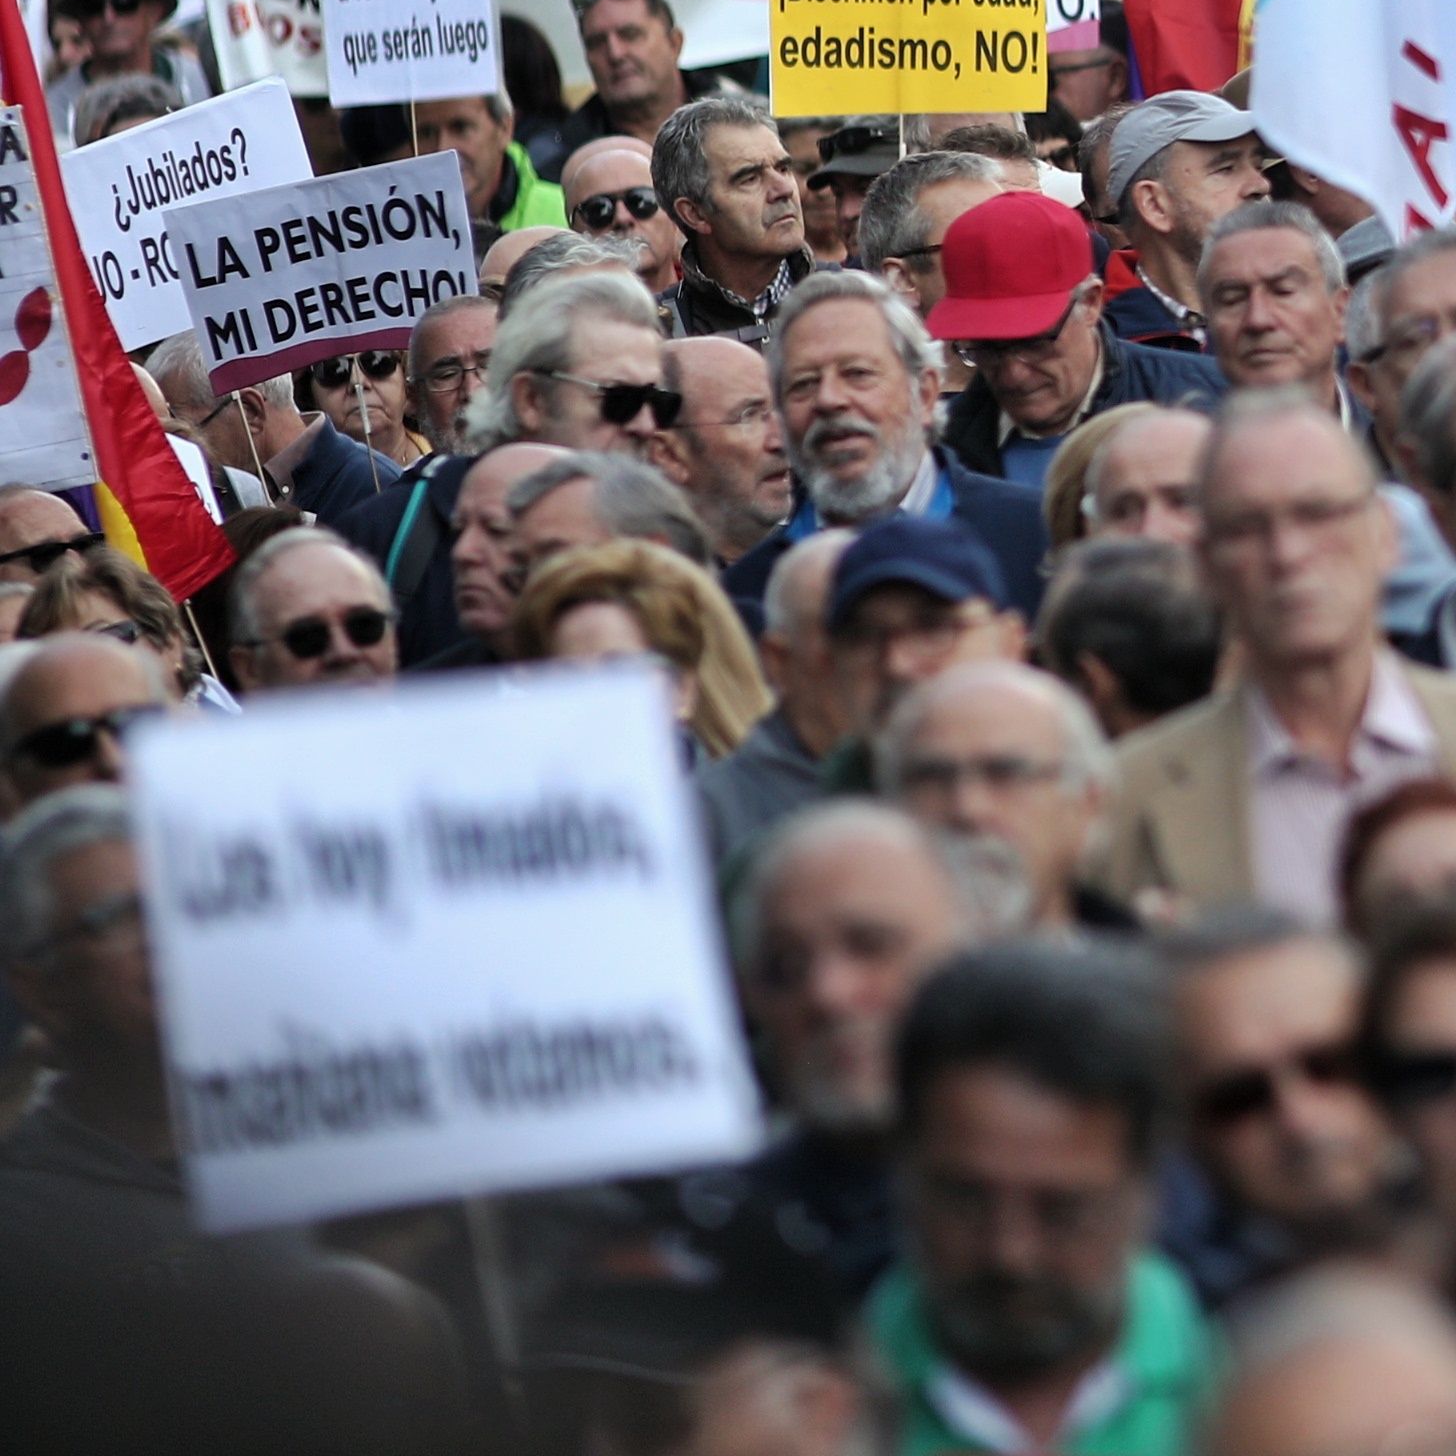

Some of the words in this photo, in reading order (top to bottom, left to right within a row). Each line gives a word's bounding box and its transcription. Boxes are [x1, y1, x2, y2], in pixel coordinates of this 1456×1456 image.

[343, 30, 378, 76] que
[382, 15, 434, 63] serán
[436, 11, 489, 63] luego
[779, 26, 962, 81] edadismo,
[974, 30, 1039, 75] NO!
[111, 127, 249, 233] ¿Jubilados?
[185, 236, 250, 289] LA
[254, 186, 461, 273] PENSIÓN,
[204, 307, 257, 360] MI
[264, 269, 468, 345] DERECHO!
